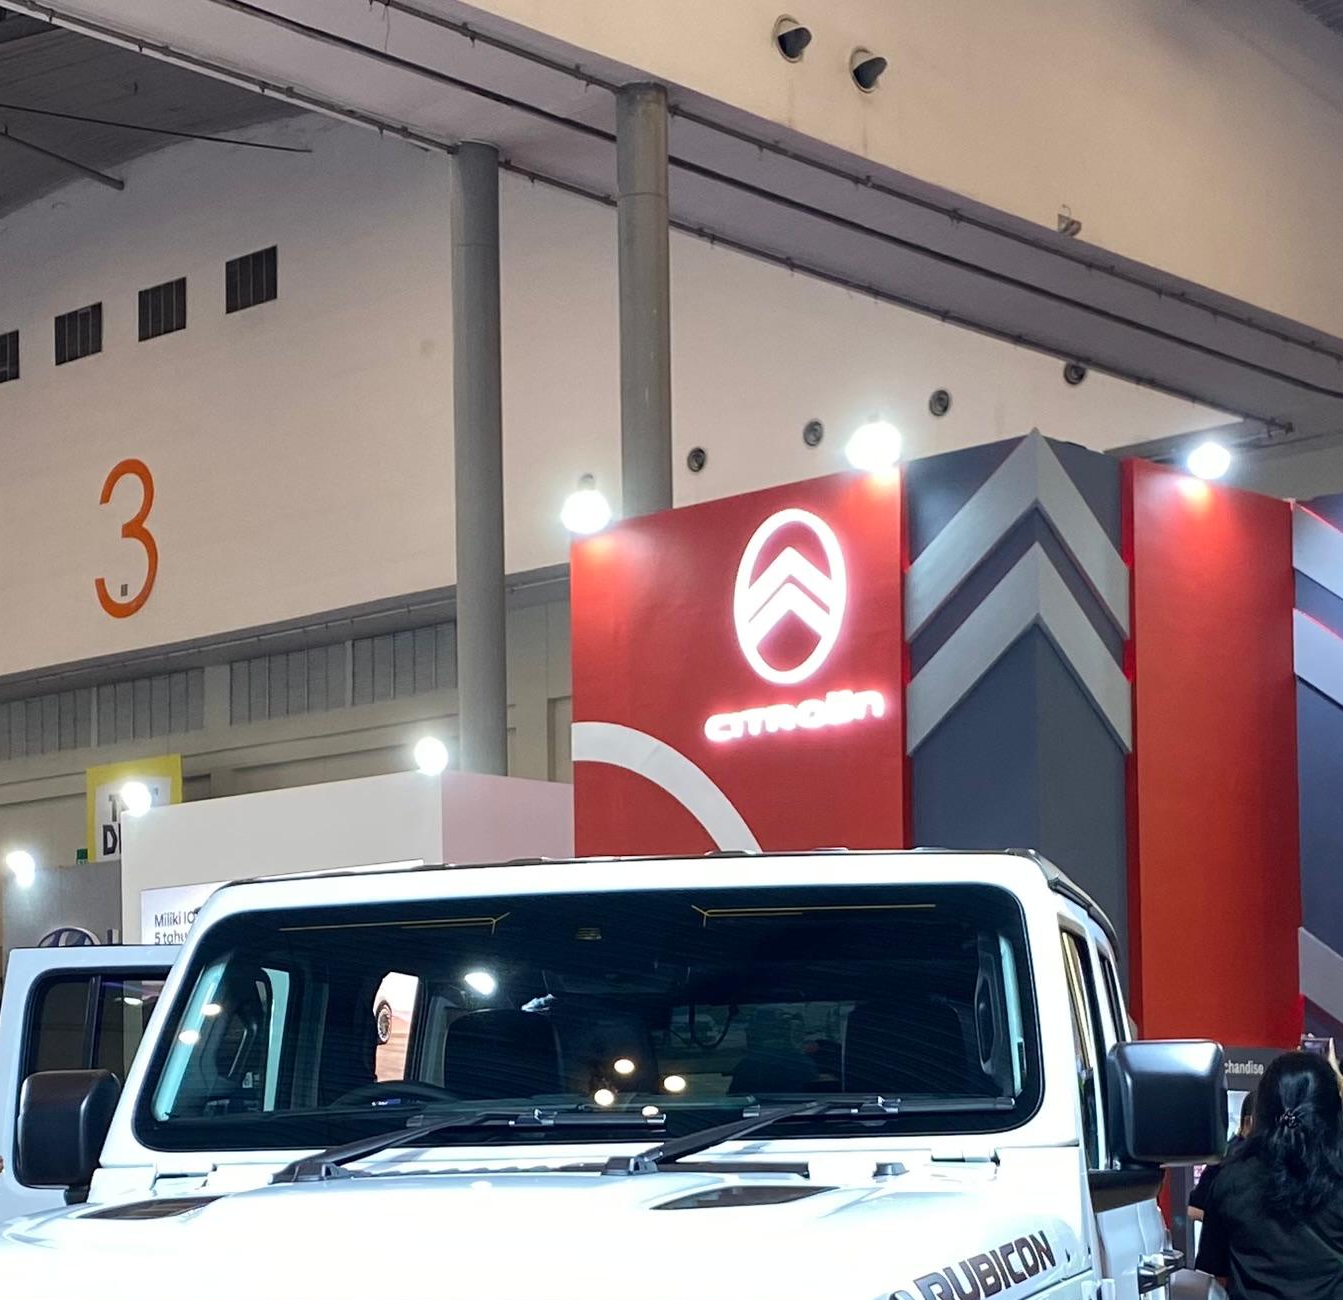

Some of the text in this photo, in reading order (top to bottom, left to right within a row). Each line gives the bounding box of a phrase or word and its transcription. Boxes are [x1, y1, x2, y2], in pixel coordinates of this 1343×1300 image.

[95, 458, 158, 618] 3
[154, 911, 182, 928] Miliki
[154, 932, 161, 945] 5
